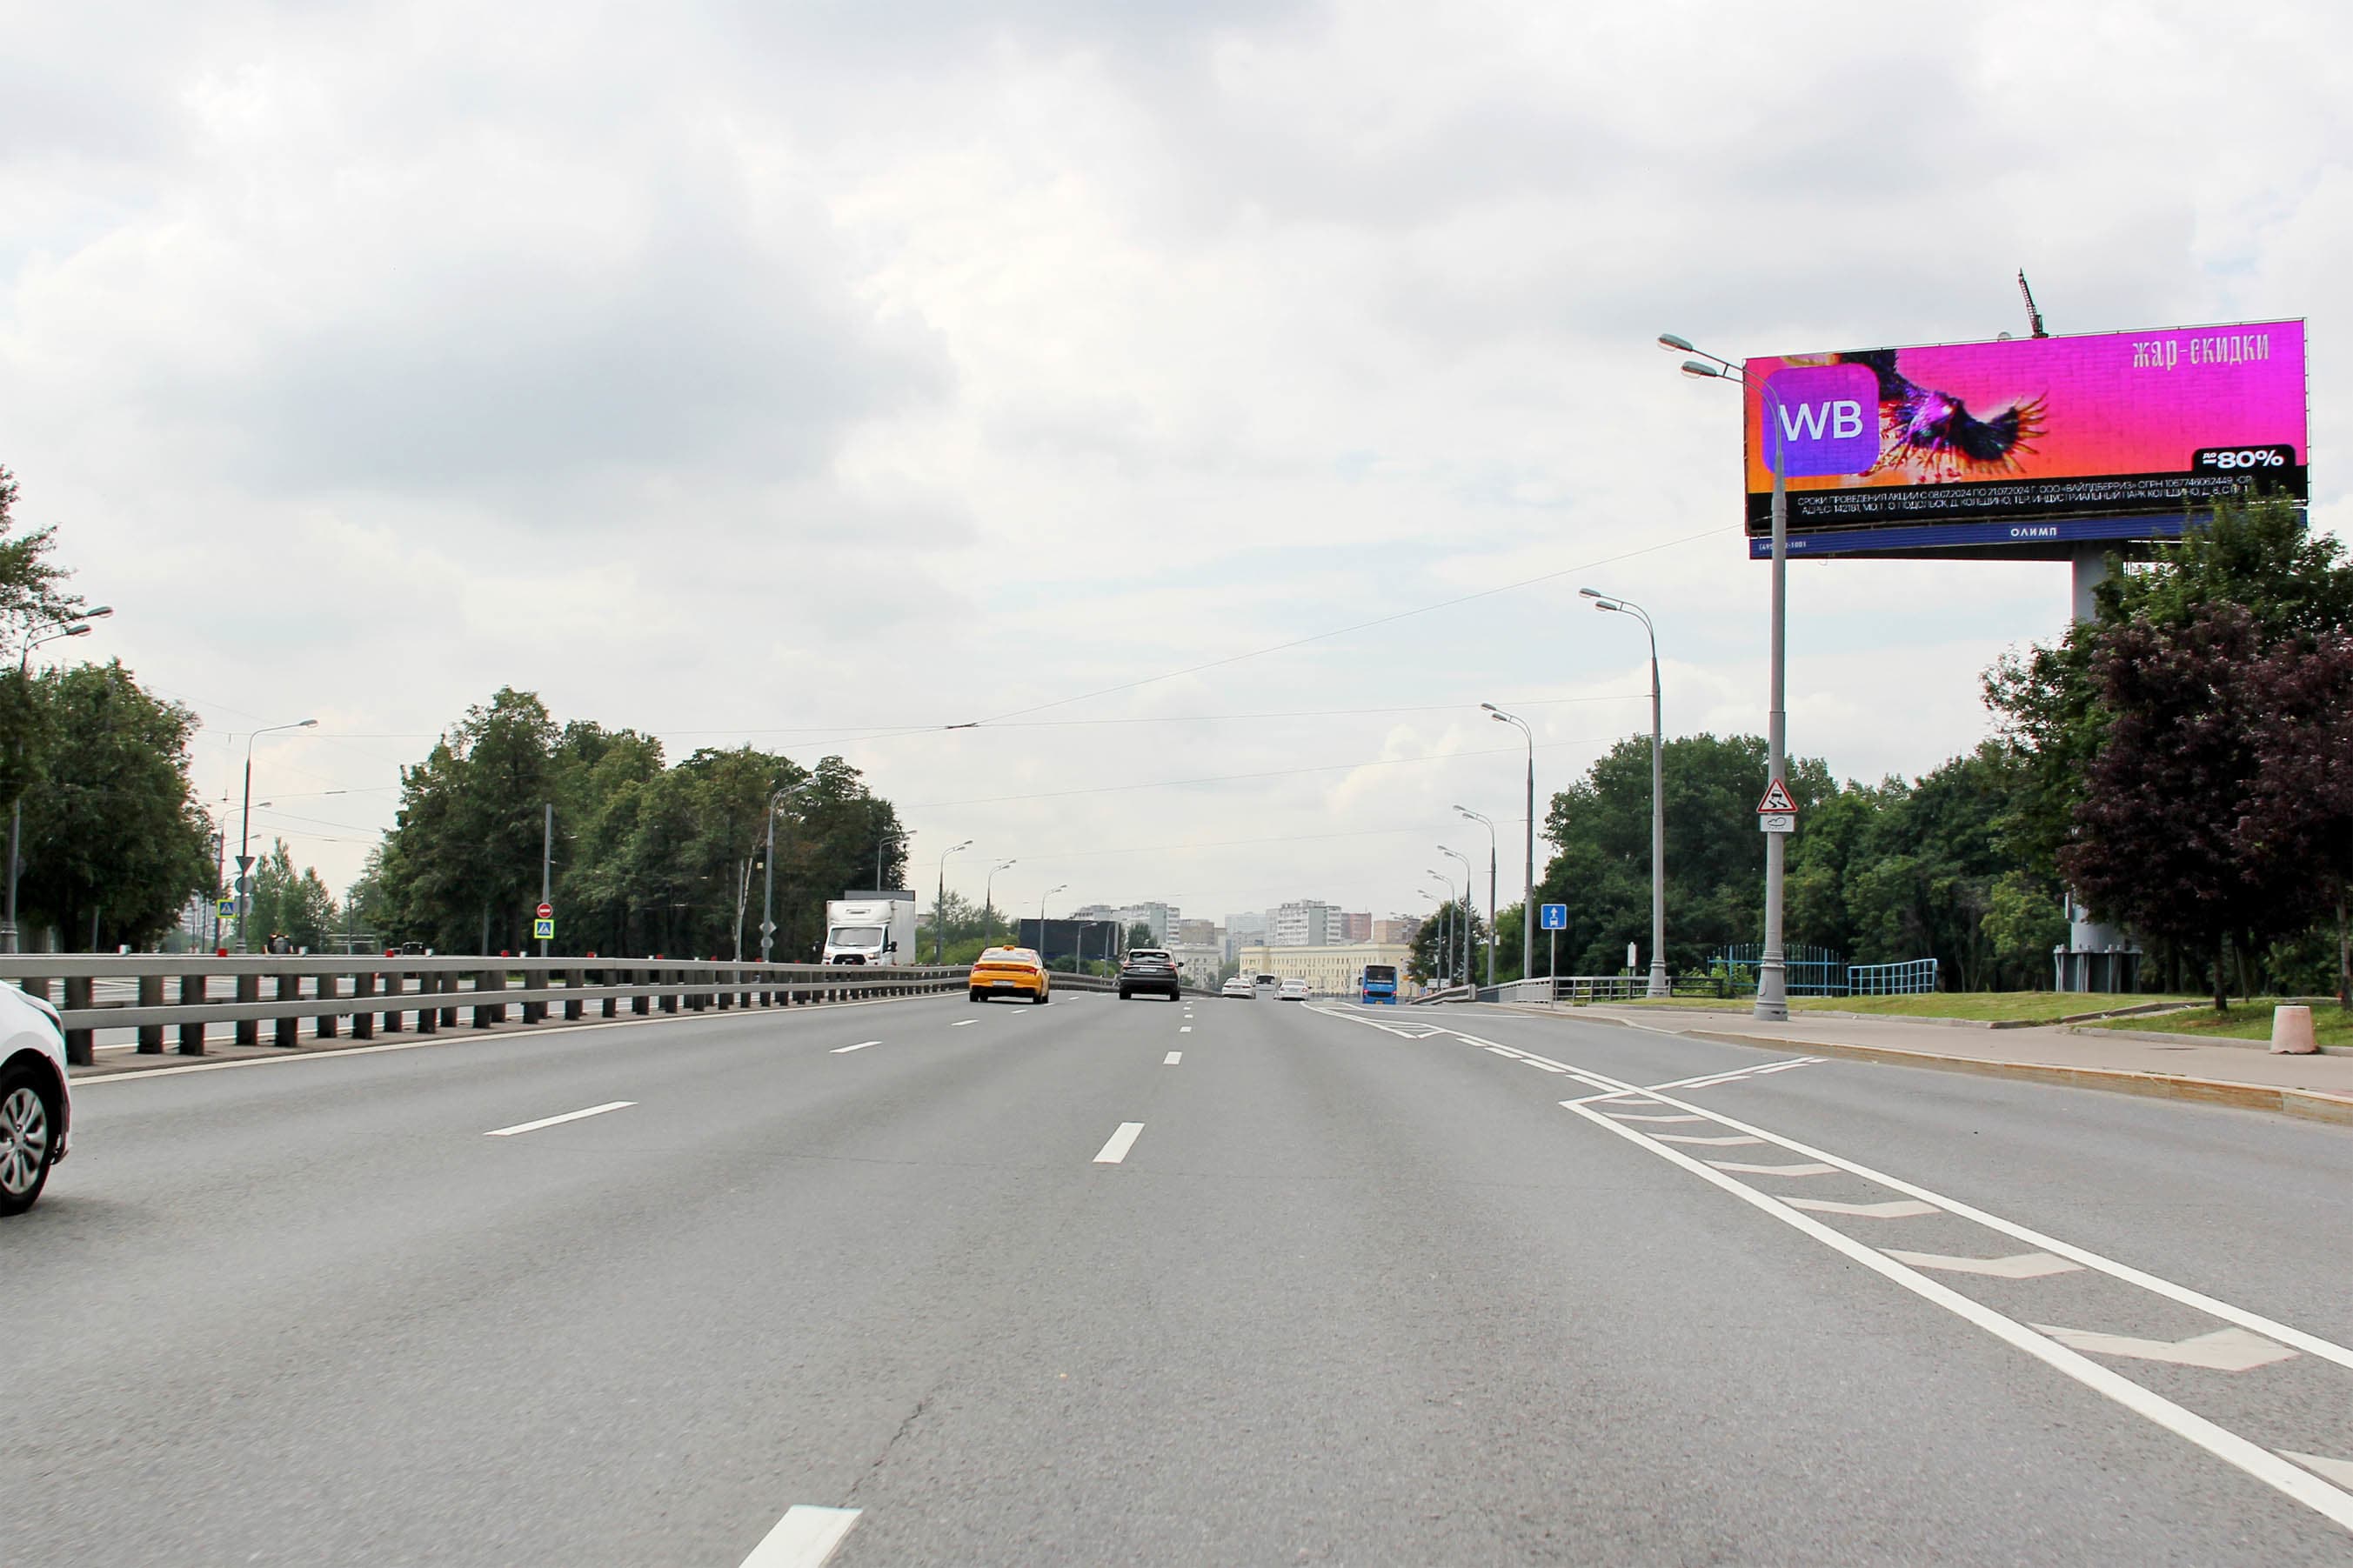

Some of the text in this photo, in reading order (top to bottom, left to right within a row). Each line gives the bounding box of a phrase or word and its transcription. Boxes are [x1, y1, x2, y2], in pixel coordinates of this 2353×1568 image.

[1779, 400, 1864, 442] WB
[1797, 497, 1828, 506] СРОКИ
[1829, 494, 1888, 504] ПРОВЕДЕНИЯ
[1888, 491, 1919, 502] АКЦИИ
[1920, 490, 1928, 499] С
[1973, 488, 1987, 497] ПО
[2040, 484, 2061, 494] ООО
[2138, 479, 2163, 490] ОГРН
[2010, 527, 2057, 537] ОЛИМП
